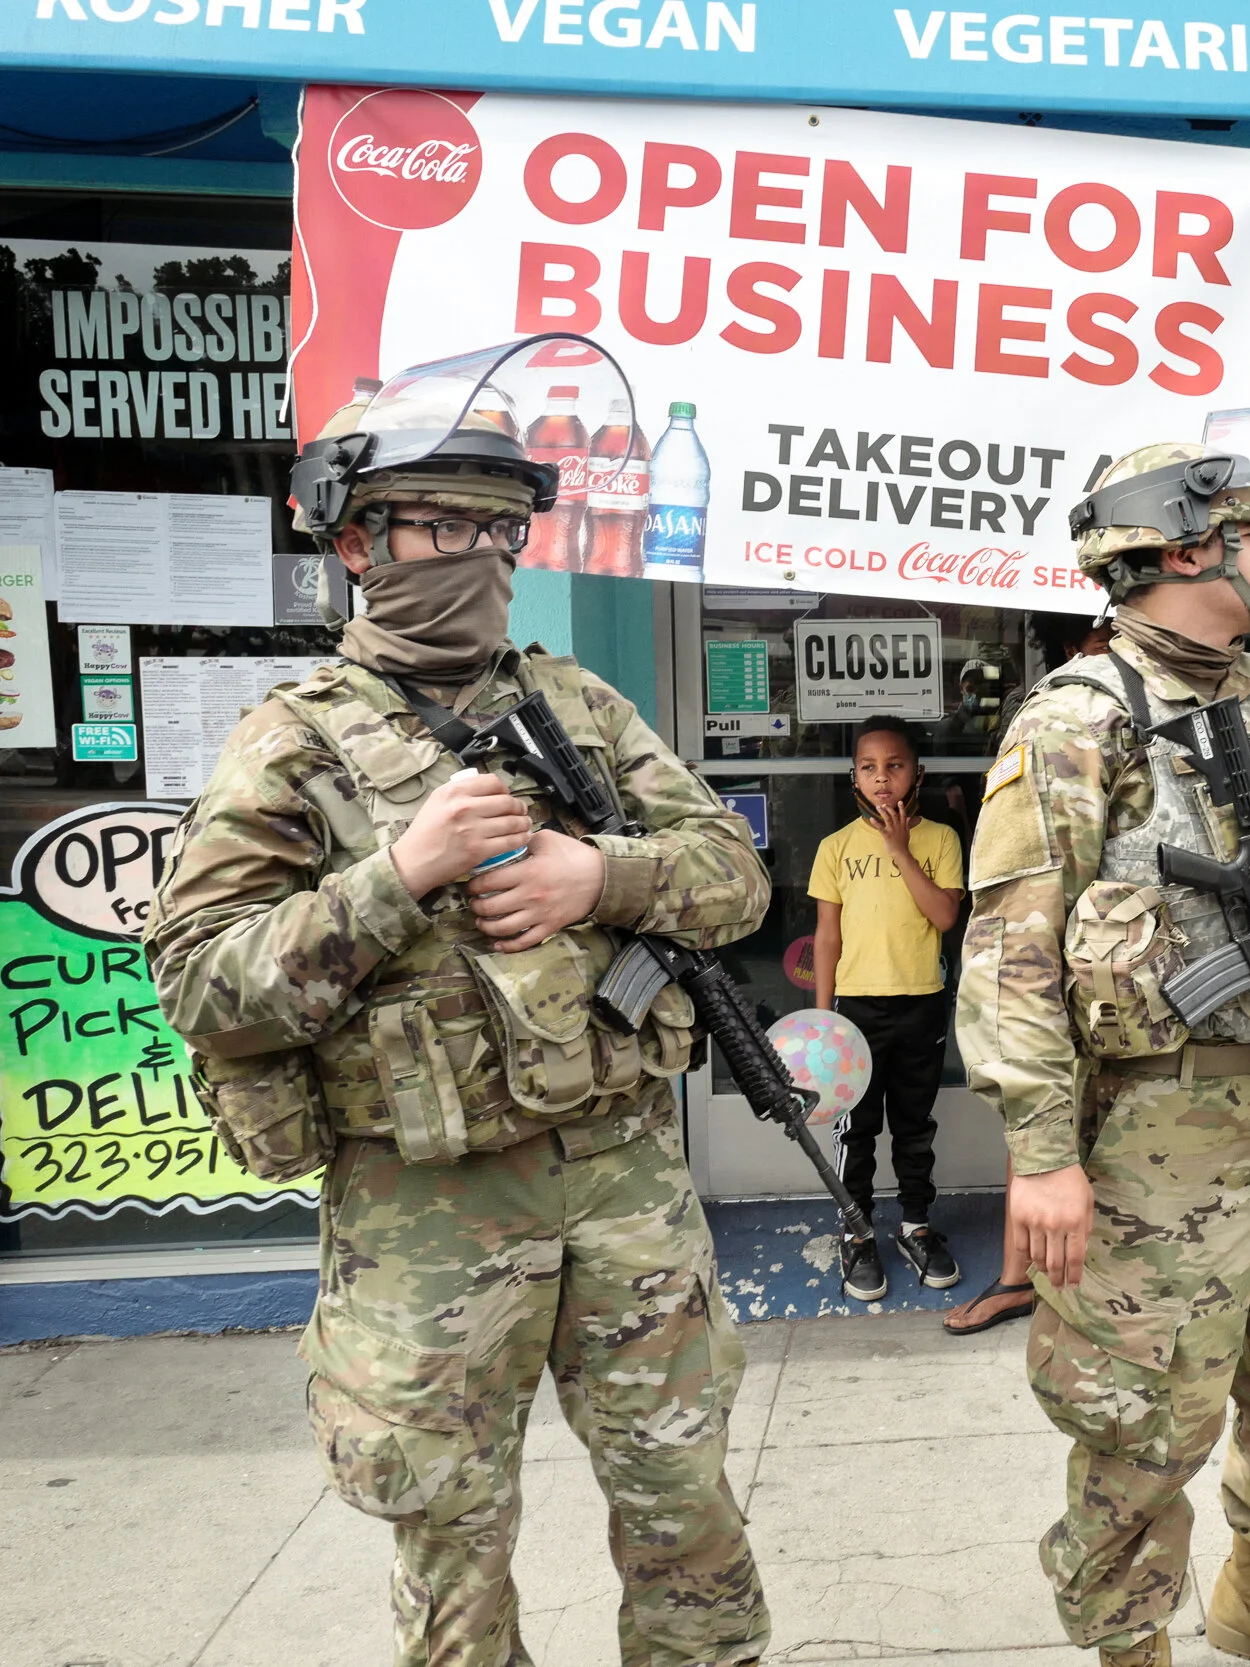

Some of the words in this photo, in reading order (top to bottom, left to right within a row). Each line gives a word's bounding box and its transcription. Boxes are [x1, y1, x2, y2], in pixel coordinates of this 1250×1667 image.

[489, 0, 756, 53] VEGAN
[336, 134, 478, 184] Coca-Cola
[523, 131, 912, 254] OPEN
[960, 171, 1235, 287] FOR
[53, 289, 291, 362] IMPOSSIB
[514, 241, 1225, 397] BUSINESS
[39, 370, 221, 439] SERVED
[230, 372, 298, 440] HE
[768, 423, 1066, 490] TAKEOUT
[645, 508, 706, 539] DASANI
[741, 470, 1051, 537] DELIVERY
[0, 574, 34, 587] GER
[745, 541, 793, 566] ICE
[803, 545, 888, 573] COLD
[897, 541, 1030, 590] Coca-Cola
[1032, 565, 1103, 591] SER
[804, 633, 932, 682] CLOSED
[706, 720, 741, 731] Pull
[836, 701, 857, 709] phone
[78, 736, 111, 746] WI-FI
[79, 726, 110, 736] FREE
[843, 853, 935, 881] WISA
[0, 947, 153, 990] CUR
[137, 1036, 175, 1081] &
[22, 1072, 209, 1131] DELI
